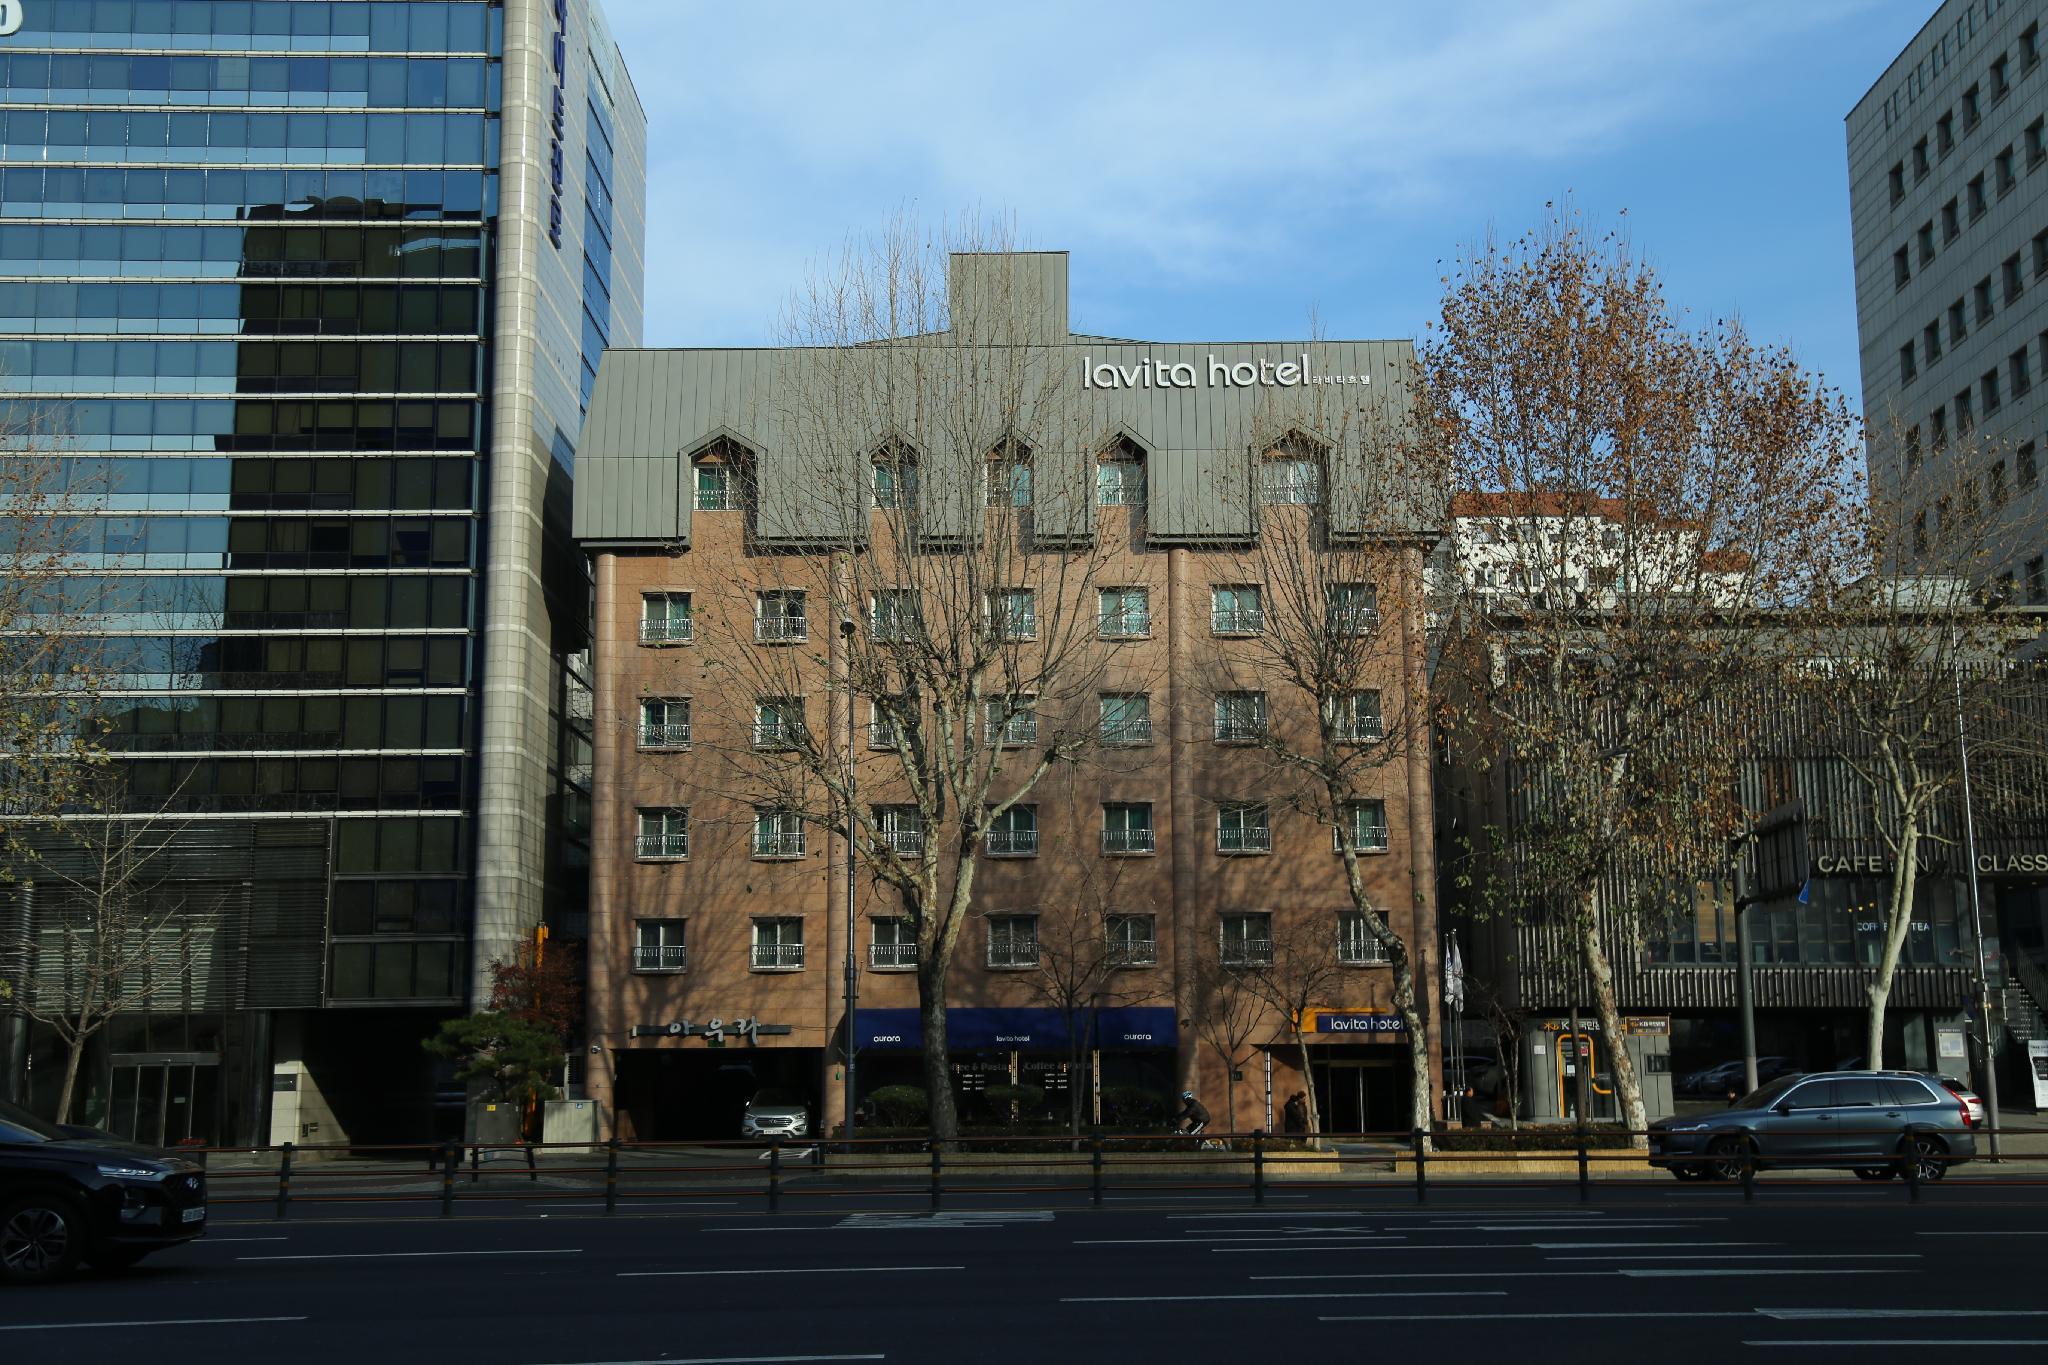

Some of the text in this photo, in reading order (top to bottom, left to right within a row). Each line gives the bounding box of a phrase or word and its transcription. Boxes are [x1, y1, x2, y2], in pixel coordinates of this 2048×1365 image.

[1083, 353, 1309, 388] lavita hotel
[1312, 374, 1370, 386] 라비타호텔
[1818, 856, 1883, 873] CAFE
[1977, 854, 2048, 872] CLASS
[1911, 922, 1930, 932] TEA
[1331, 1017, 1404, 1030] lavita hotel
[873, 1035, 901, 1043] aurora
[1123, 1033, 1152, 1041] aurora
[1023, 1061, 1056, 1072] Coffee
